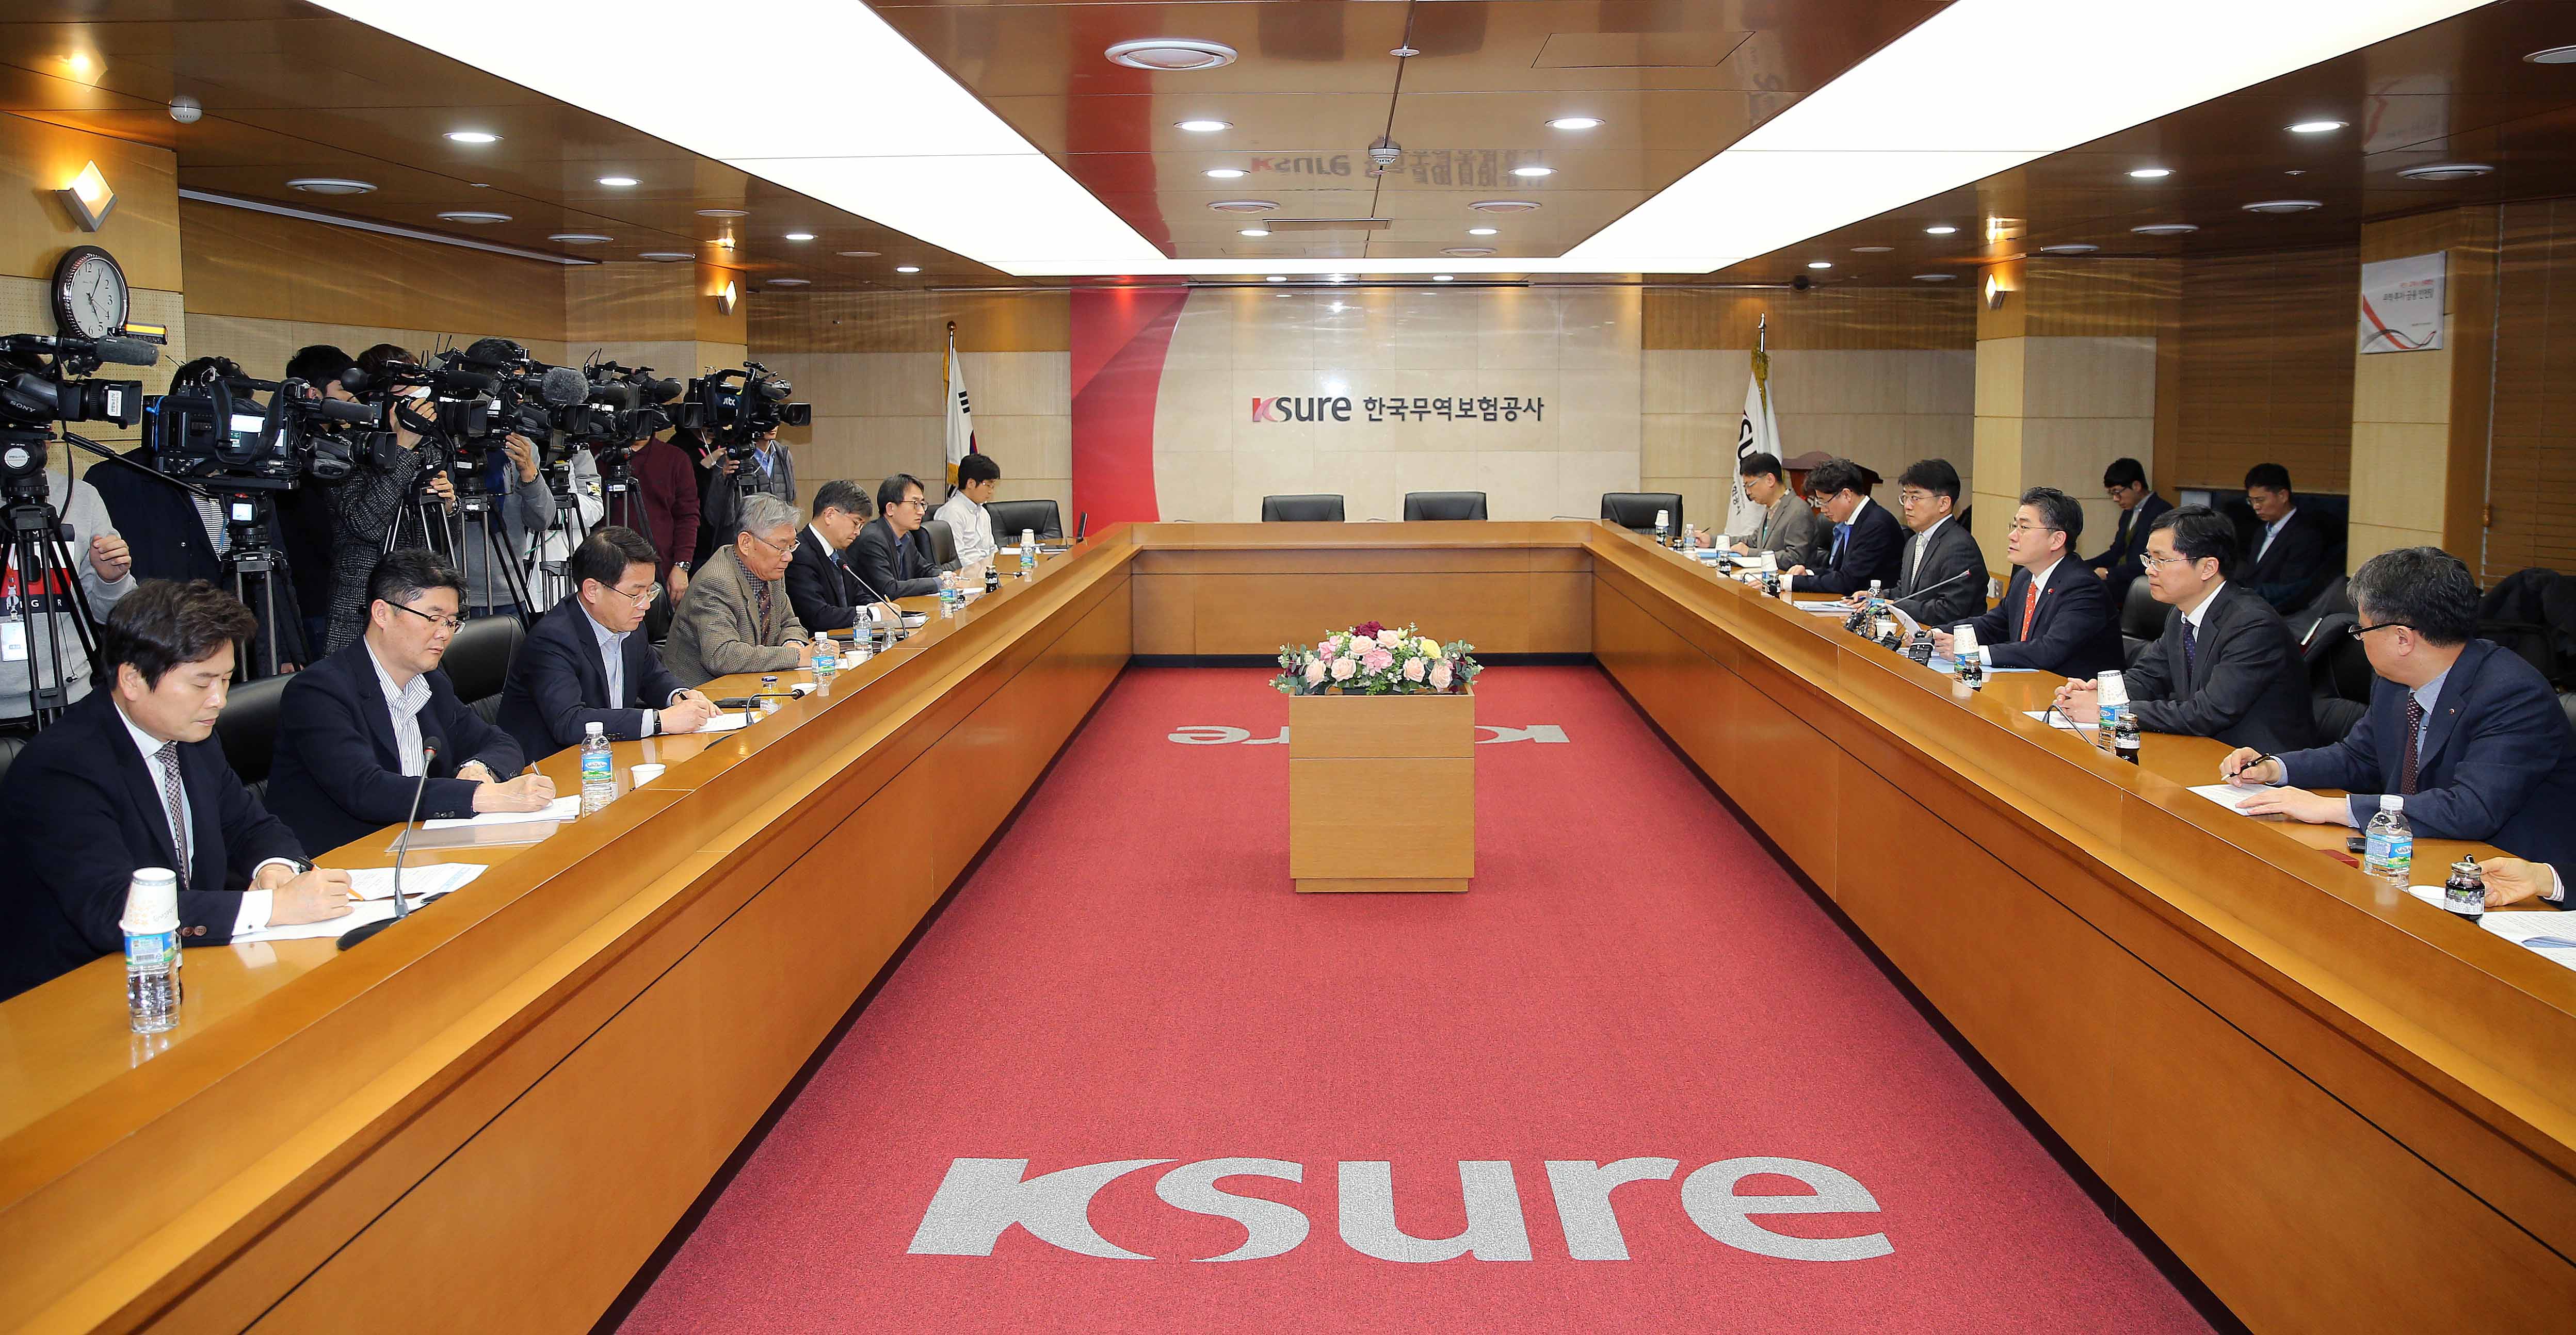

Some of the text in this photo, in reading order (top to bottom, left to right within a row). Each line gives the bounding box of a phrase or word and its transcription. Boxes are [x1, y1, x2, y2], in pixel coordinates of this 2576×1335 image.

[85, 263, 92, 272] 12
[105, 279, 109, 289] 2
[107, 295, 113, 305] 3
[105, 311, 110, 320] 4
[88, 325, 93, 335] 6
[99, 321, 103, 332] 5
[10, 400, 36, 413] SONY
[1252, 396, 1544, 422] Ksure 한국무역보험공사
[905, 1157, 1896, 1263] Ksure
